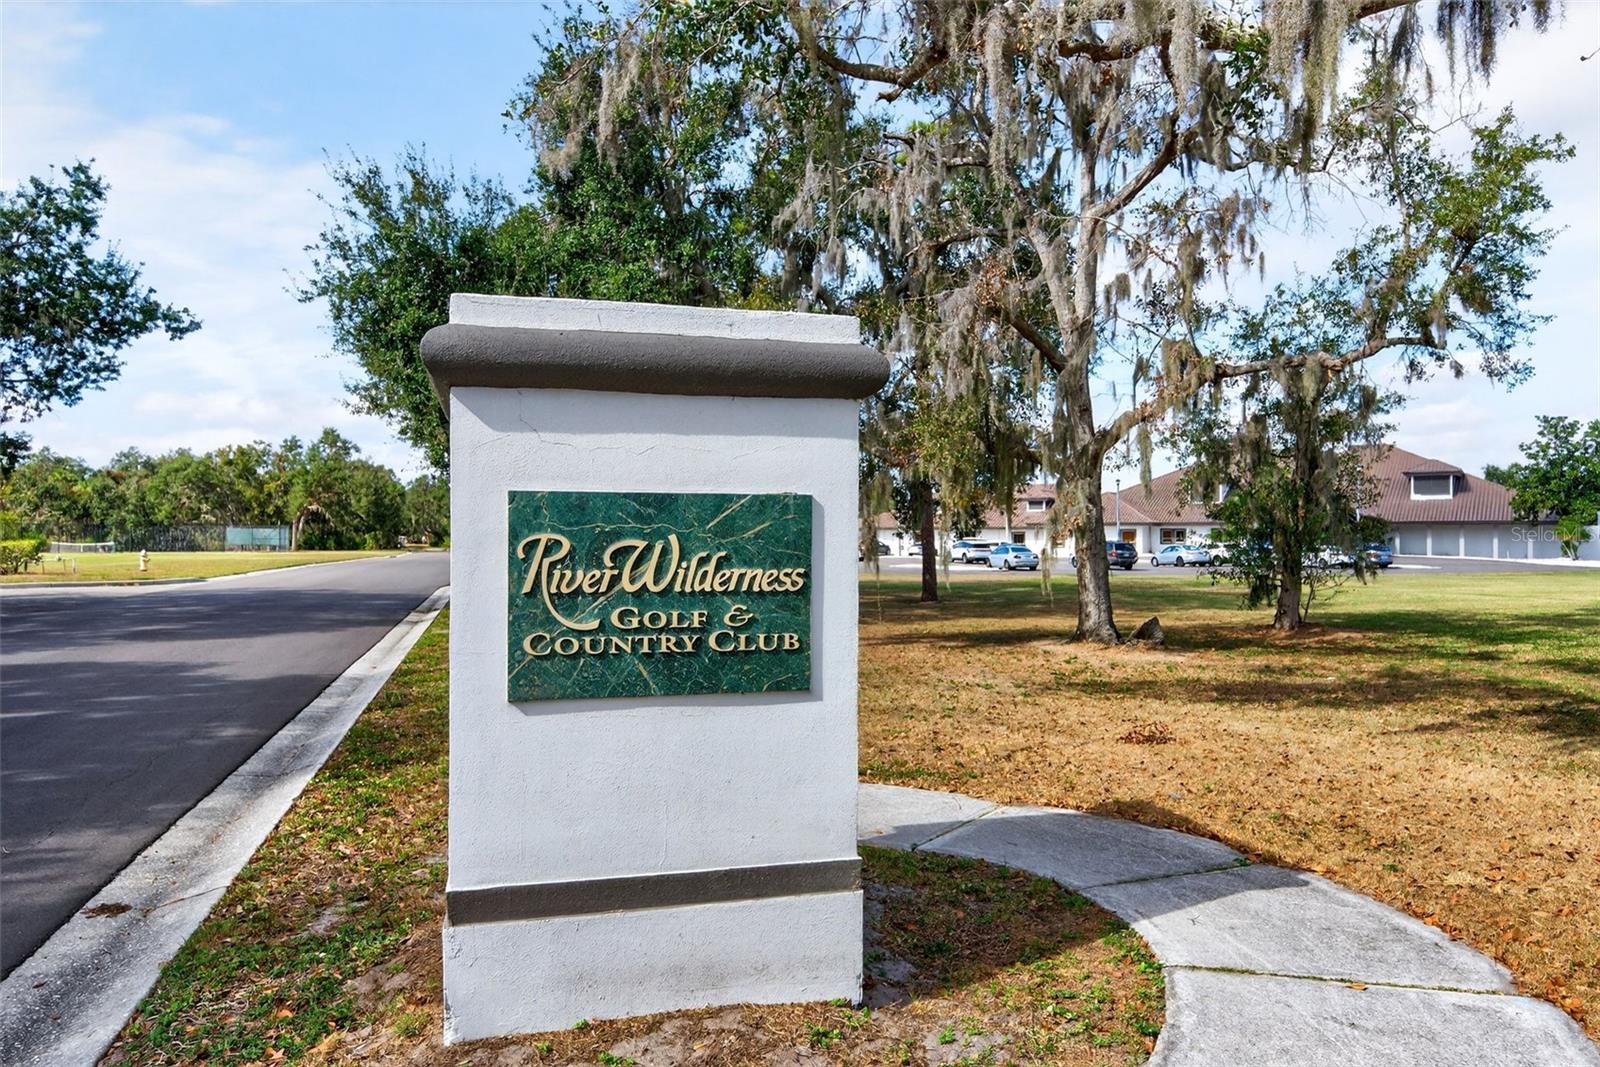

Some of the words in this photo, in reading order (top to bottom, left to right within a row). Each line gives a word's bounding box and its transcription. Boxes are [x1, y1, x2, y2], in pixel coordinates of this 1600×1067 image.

[517, 534, 618, 630] River
[603, 534, 805, 593] Wilderness
[610, 607, 708, 629] GOLF
[723, 605, 754, 627] &
[523, 632, 701, 657] COUNTRY
[708, 630, 800, 652] CLUB
